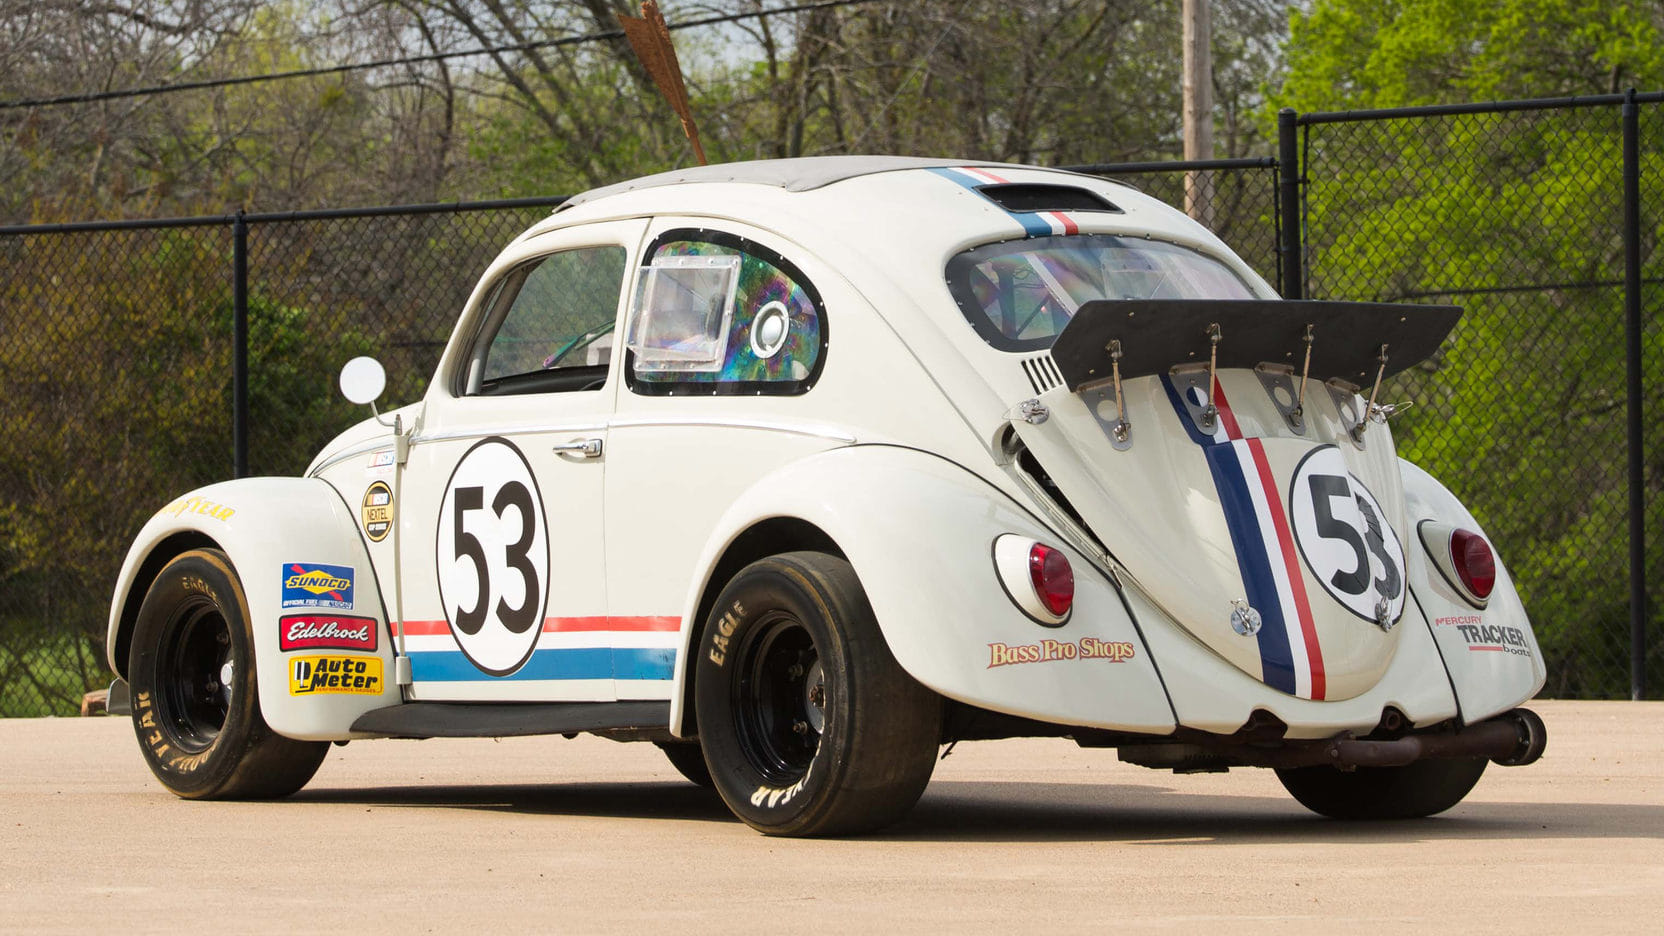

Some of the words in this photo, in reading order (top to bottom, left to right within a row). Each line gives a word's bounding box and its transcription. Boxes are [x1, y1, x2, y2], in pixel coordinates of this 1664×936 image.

[366, 507, 388, 520] NEXTEL
[1308, 474, 1401, 600] 53
[454, 480, 540, 636] 53
[288, 576, 348, 589] SUNOCO
[1435, 615, 1482, 626] MERCURY
[287, 621, 369, 641] Edelbrock
[709, 600, 748, 667] EAGLE
[1457, 625, 1527, 647] TRACKER
[987, 642, 1040, 669] Bass
[1040, 639, 1077, 662] Pro
[1079, 637, 1135, 663] Shops
[1502, 645, 1532, 657] boats
[314, 658, 367, 673] Auto
[310, 673, 378, 691] Meter
